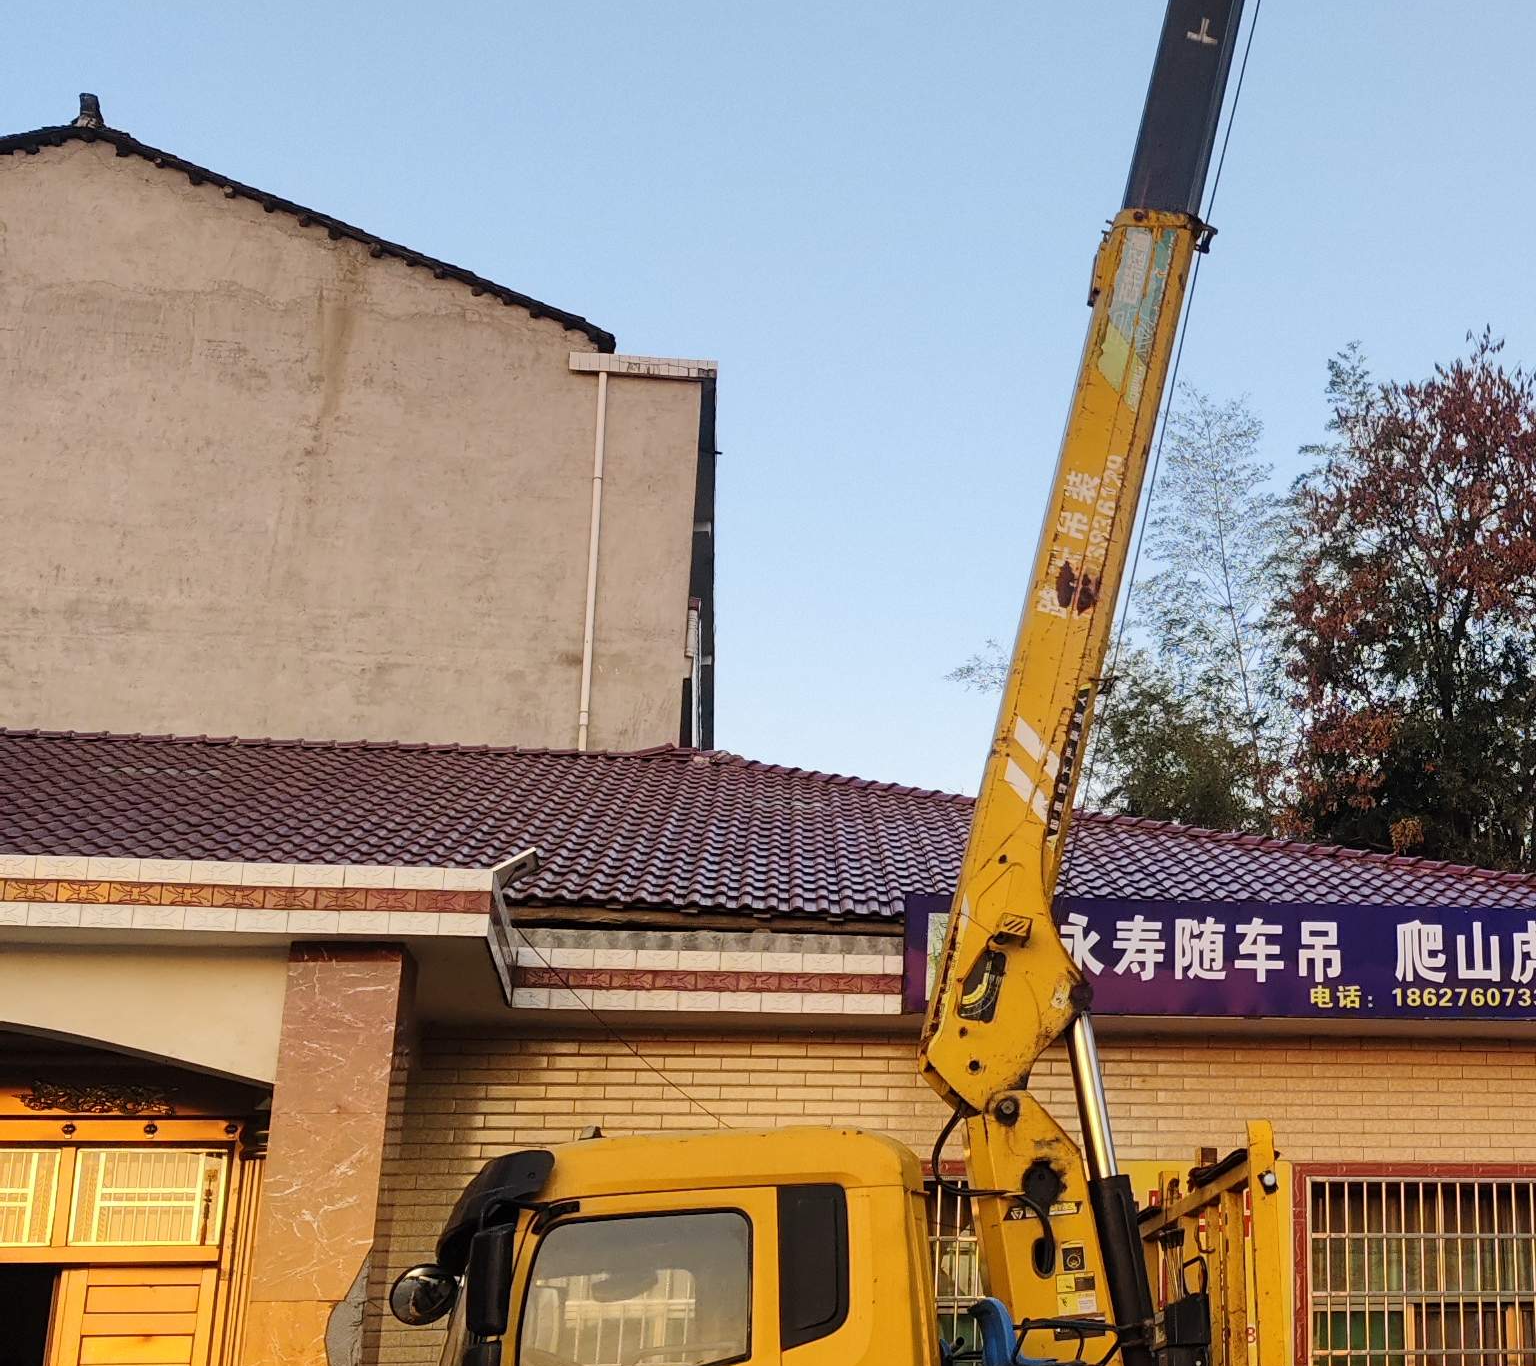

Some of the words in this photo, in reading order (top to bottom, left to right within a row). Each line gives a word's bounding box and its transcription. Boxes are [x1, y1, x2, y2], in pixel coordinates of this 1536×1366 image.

[1060, 912, 1342, 983] 永寿随车吊
